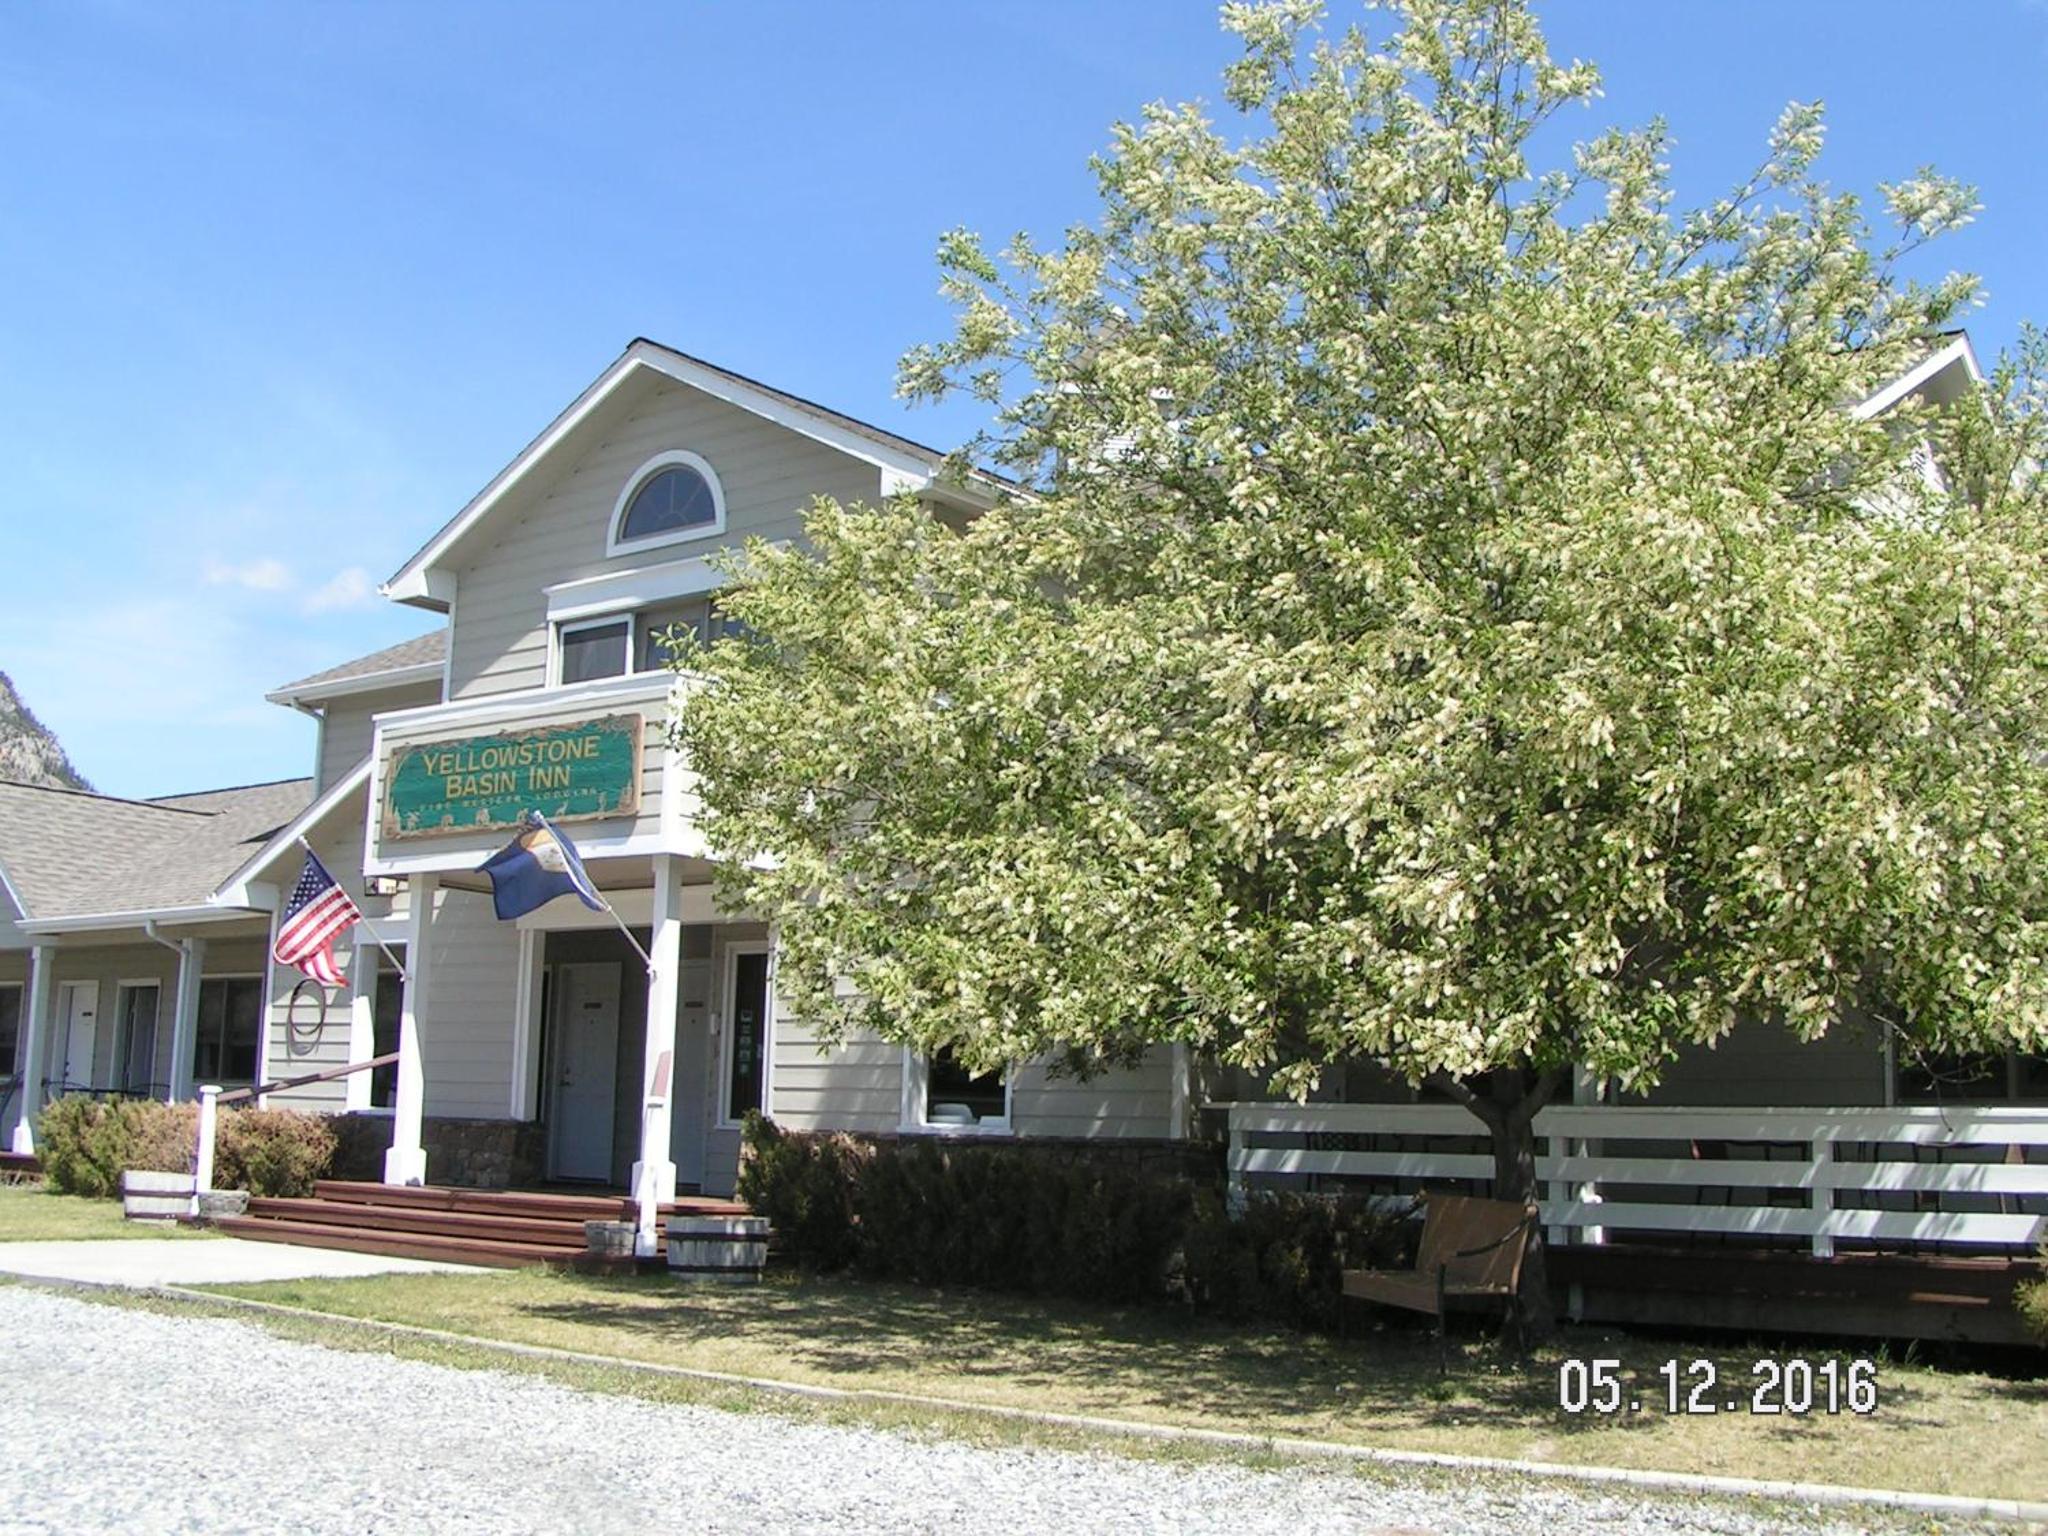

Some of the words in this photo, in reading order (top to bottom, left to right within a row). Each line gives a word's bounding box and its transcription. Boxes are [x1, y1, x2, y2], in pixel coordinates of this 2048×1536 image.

[423, 735, 600, 777] YELLOWSTONE
[445, 774, 516, 799] BASIN
[528, 765, 571, 791] INN
